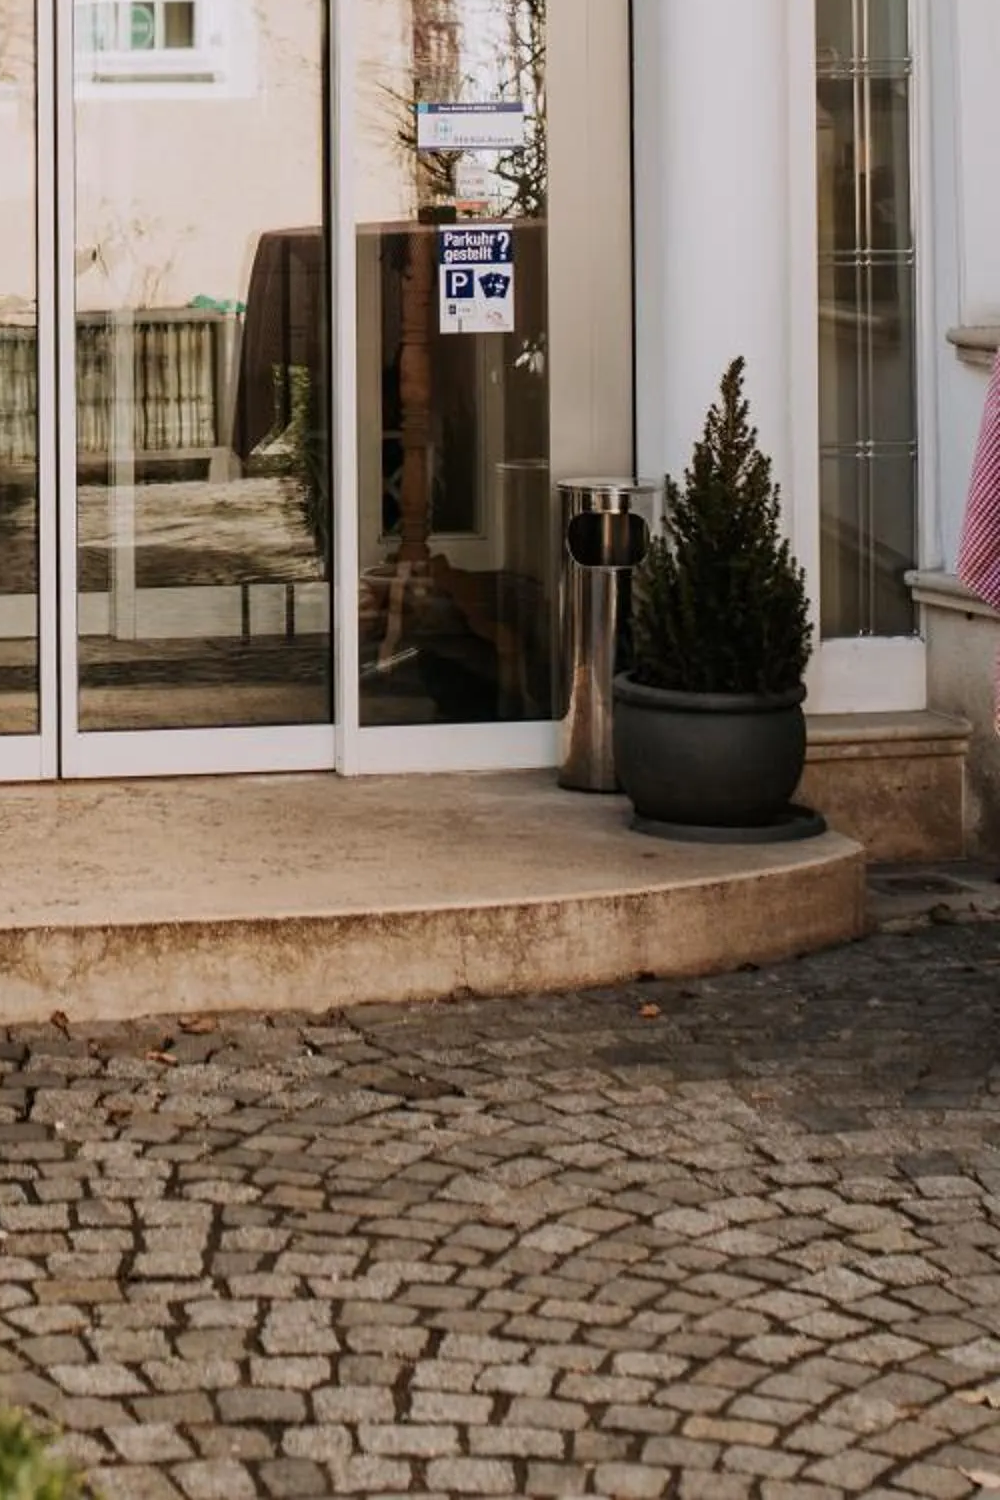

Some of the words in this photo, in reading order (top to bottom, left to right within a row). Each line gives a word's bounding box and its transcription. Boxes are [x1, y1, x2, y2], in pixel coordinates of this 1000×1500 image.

[443, 231, 495, 247] Parkuhr
[443, 246, 493, 264] gestellt
[451, 272, 469, 296] P
